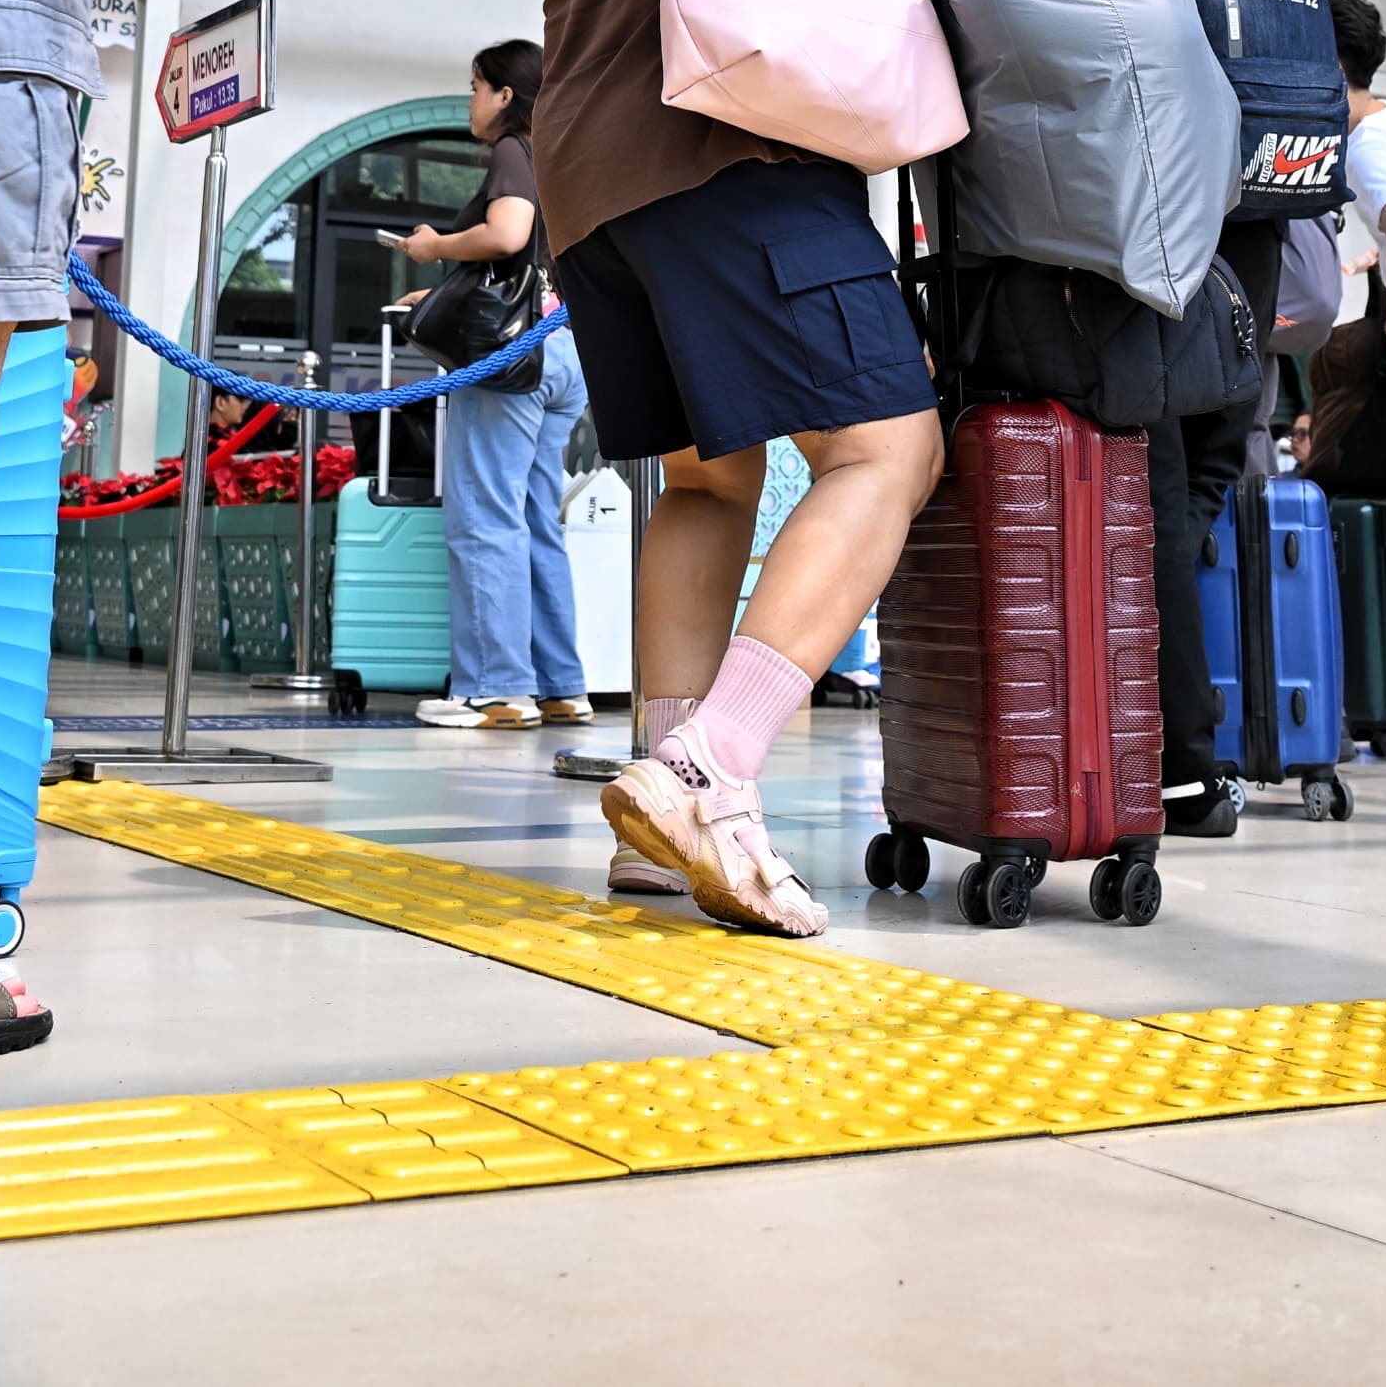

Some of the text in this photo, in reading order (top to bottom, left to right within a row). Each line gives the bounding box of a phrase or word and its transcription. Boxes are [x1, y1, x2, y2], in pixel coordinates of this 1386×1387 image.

[192, 38, 235, 82] MENOREH
[173, 86, 180, 115] 4
[194, 92, 214, 117] Pukul
[217, 82, 235, 107] 13.35
[1266, 186, 1295, 194] APPAREL
